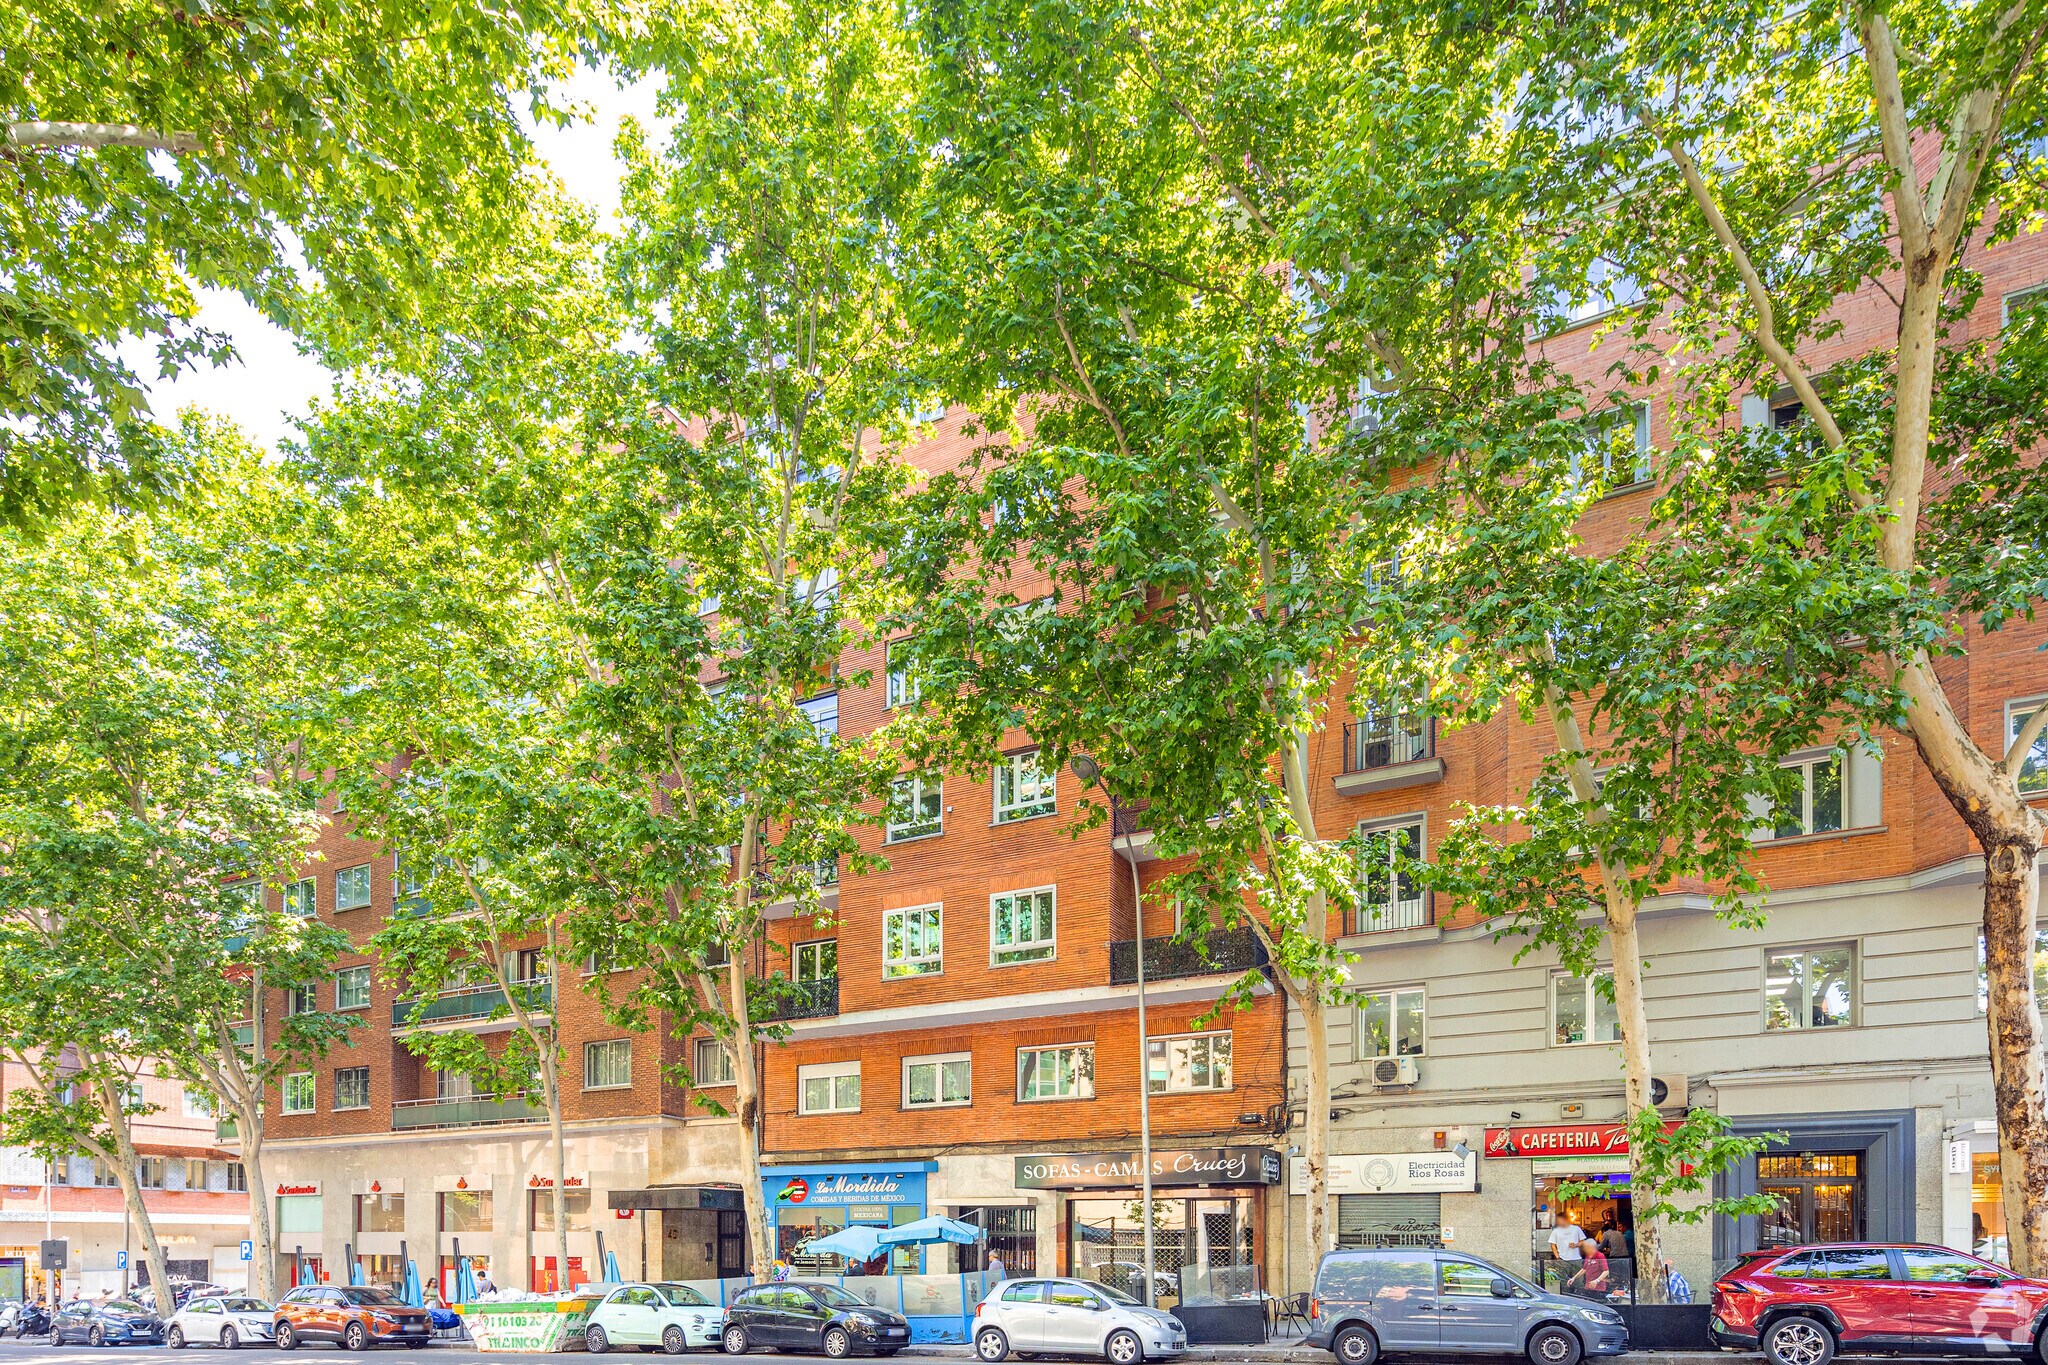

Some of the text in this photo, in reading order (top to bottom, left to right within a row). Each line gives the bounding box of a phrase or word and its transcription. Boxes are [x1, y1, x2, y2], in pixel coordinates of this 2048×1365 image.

[1521, 1131, 1600, 1150] CAFETERIA
[1023, 1163, 1080, 1180] SOFAS
[1173, 1153, 1246, 1179] Cruces
[1408, 1160, 1466, 1170] Electricidad
[1434, 1168, 1466, 1178] Rosas
[284, 1185, 317, 1195] Santander
[815, 1176, 899, 1193] La Mordida
[811, 1193, 906, 1203] COMIDAS Y BEBIDAS DE MÉXICO
[241, 1242, 251, 1260] P
[118, 1253, 126, 1269] P
